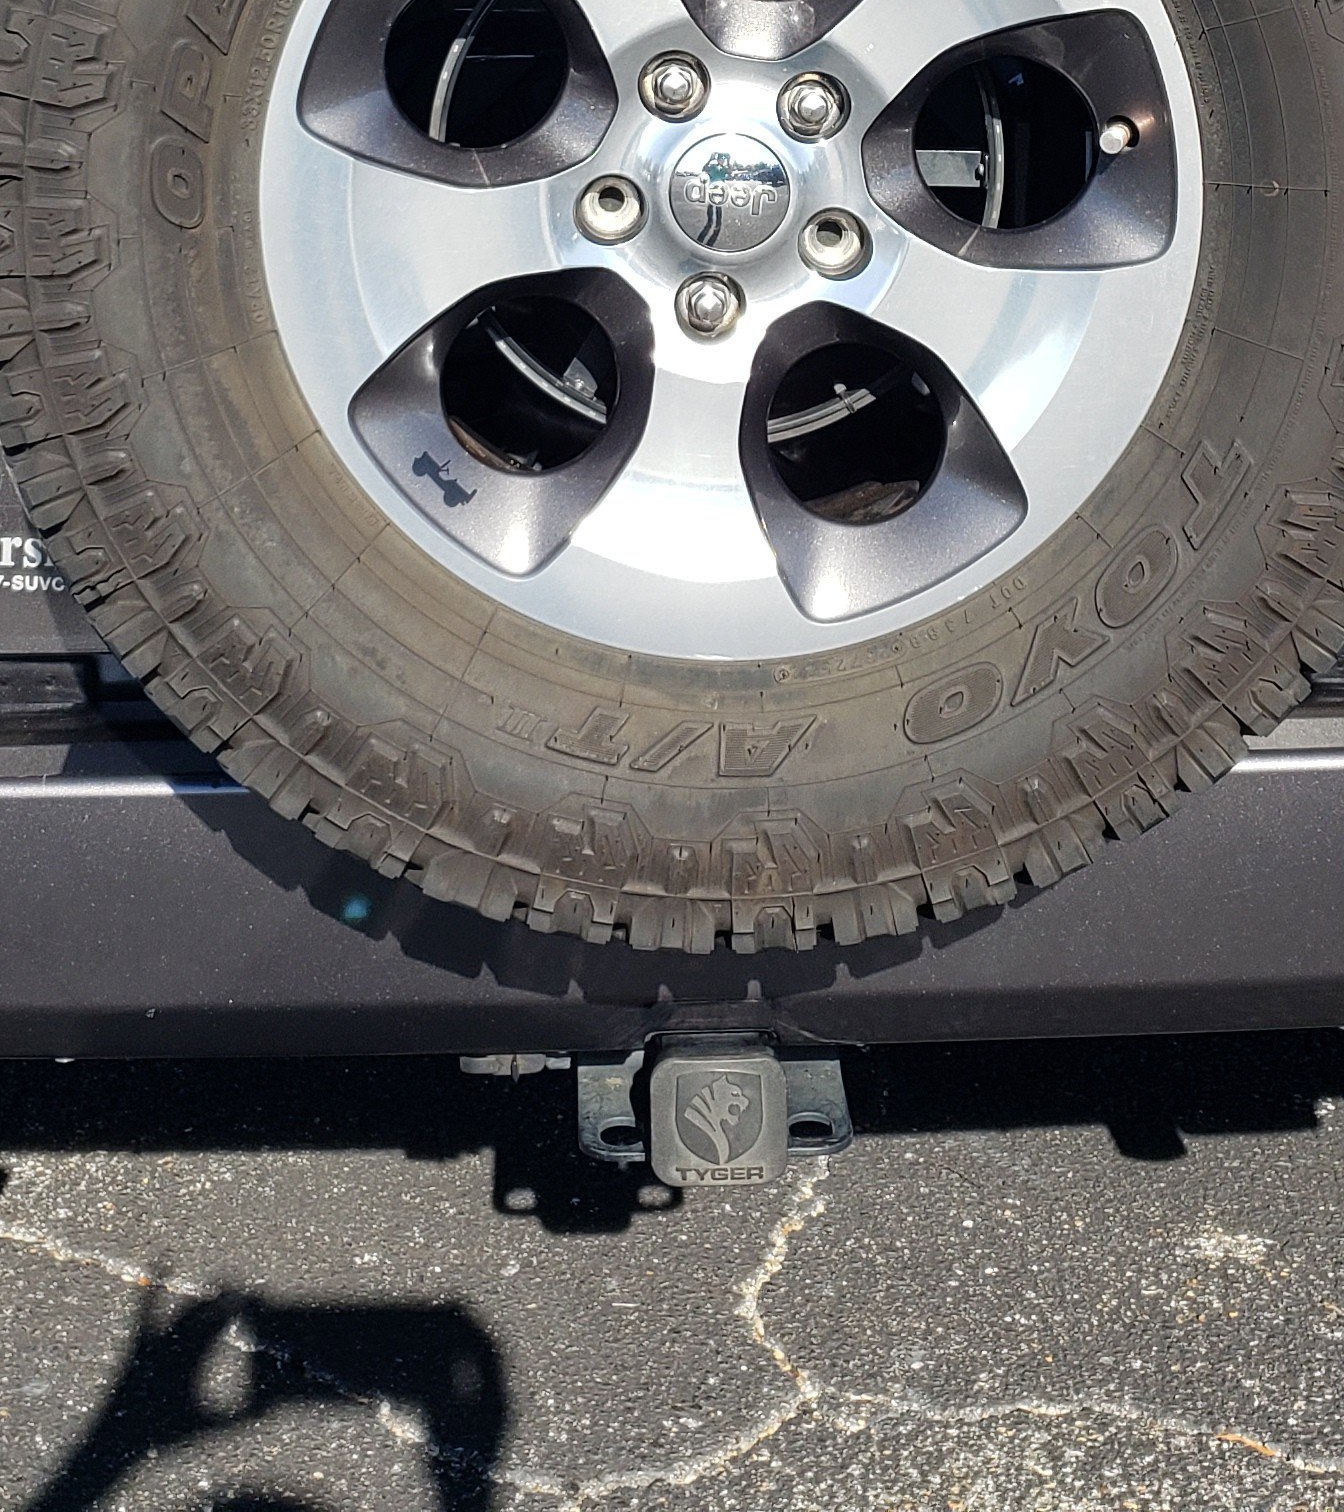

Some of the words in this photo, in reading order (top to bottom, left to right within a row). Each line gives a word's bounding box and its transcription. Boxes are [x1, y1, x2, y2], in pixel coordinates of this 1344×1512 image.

[684, 173, 777, 217] Jeep
[903, 440, 1254, 745] TOYO
[544, 713, 818, 778] A/T
[675, 1166, 764, 1182] TYGER
